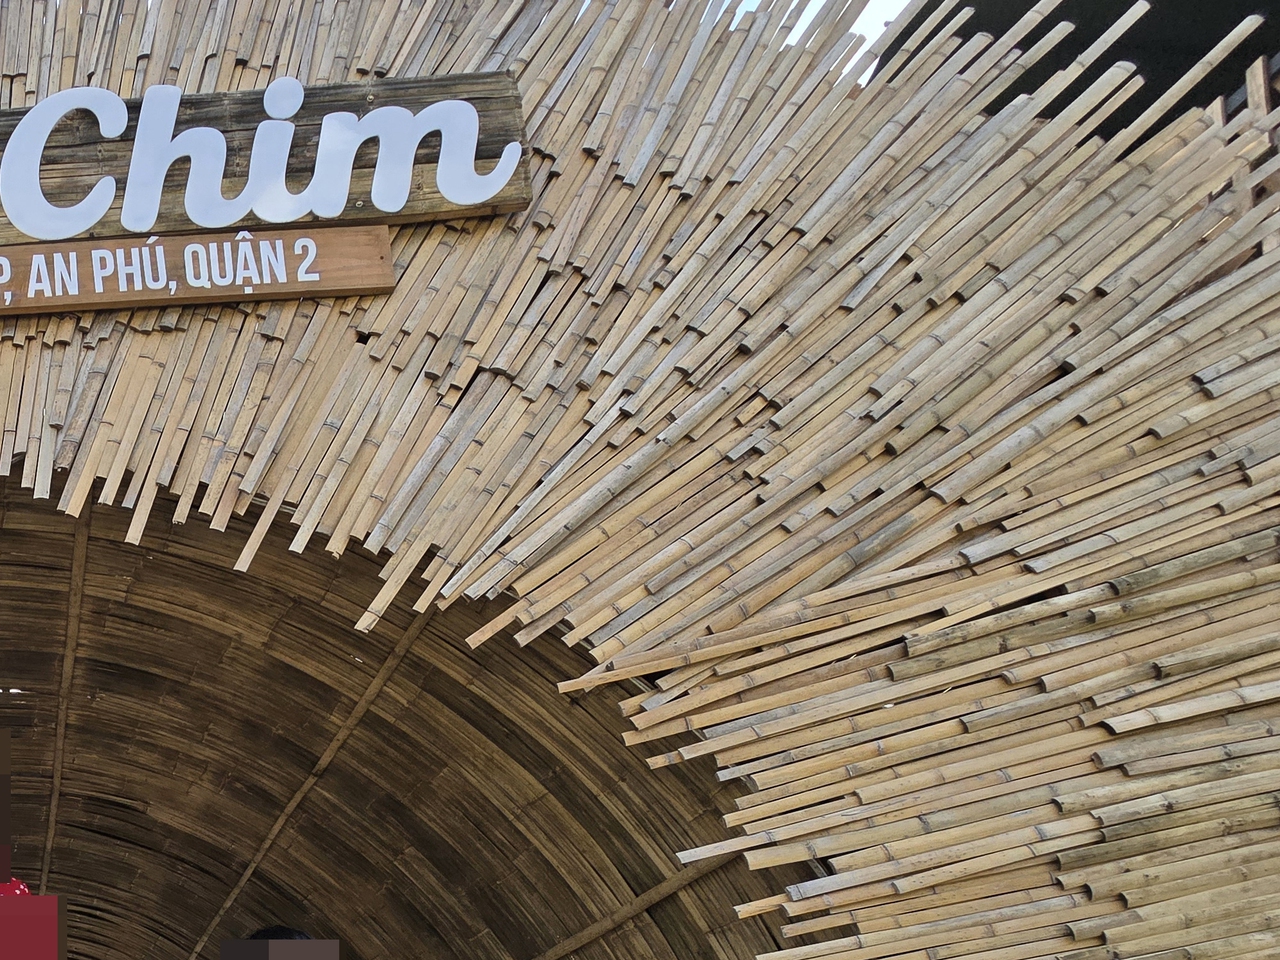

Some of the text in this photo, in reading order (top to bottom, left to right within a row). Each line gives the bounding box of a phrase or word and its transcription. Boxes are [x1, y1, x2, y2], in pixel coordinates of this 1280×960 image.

[0, 77, 521, 240] Chim
[27, 252, 78, 298] AN
[91, 236, 177, 295] PHÚ,
[184, 231, 286, 294] QUẬN
[295, 238, 320, 282] 2
